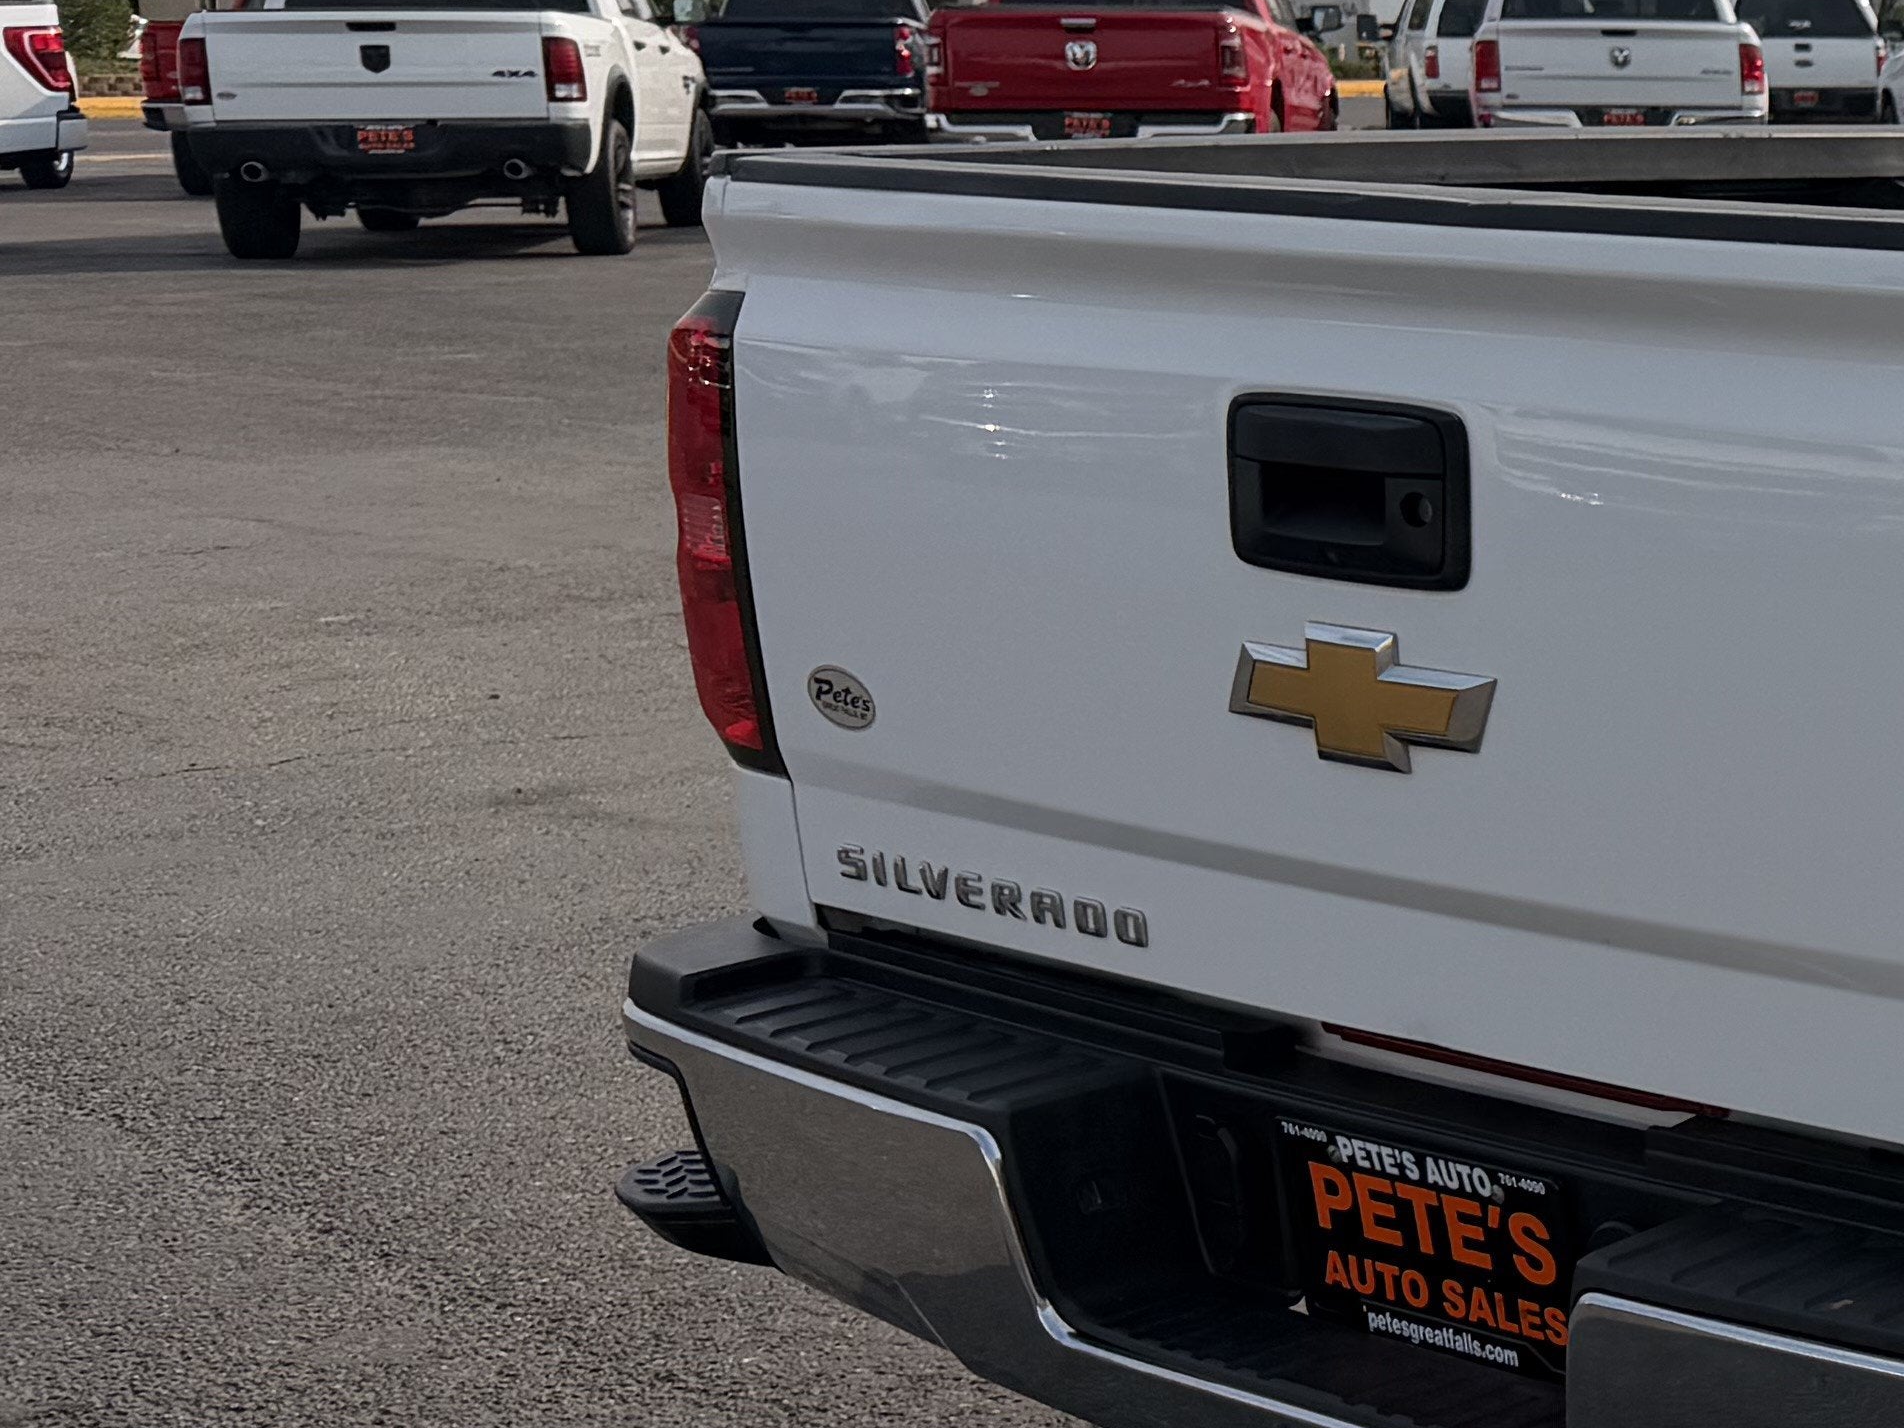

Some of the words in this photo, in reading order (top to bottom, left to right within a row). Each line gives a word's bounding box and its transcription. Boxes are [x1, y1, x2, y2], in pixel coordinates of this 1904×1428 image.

[837, 843, 1149, 948] SILVERADO
[1335, 1135, 1420, 1181] PETE'S
[1425, 1156, 1492, 1198] AUTO
[1308, 1161, 1557, 1286] PETE'S
[1325, 1250, 1429, 1308] AUTO
[1441, 1279, 1569, 1347] SALES
[1367, 1310, 1520, 1368] petesgreatfalls.com
